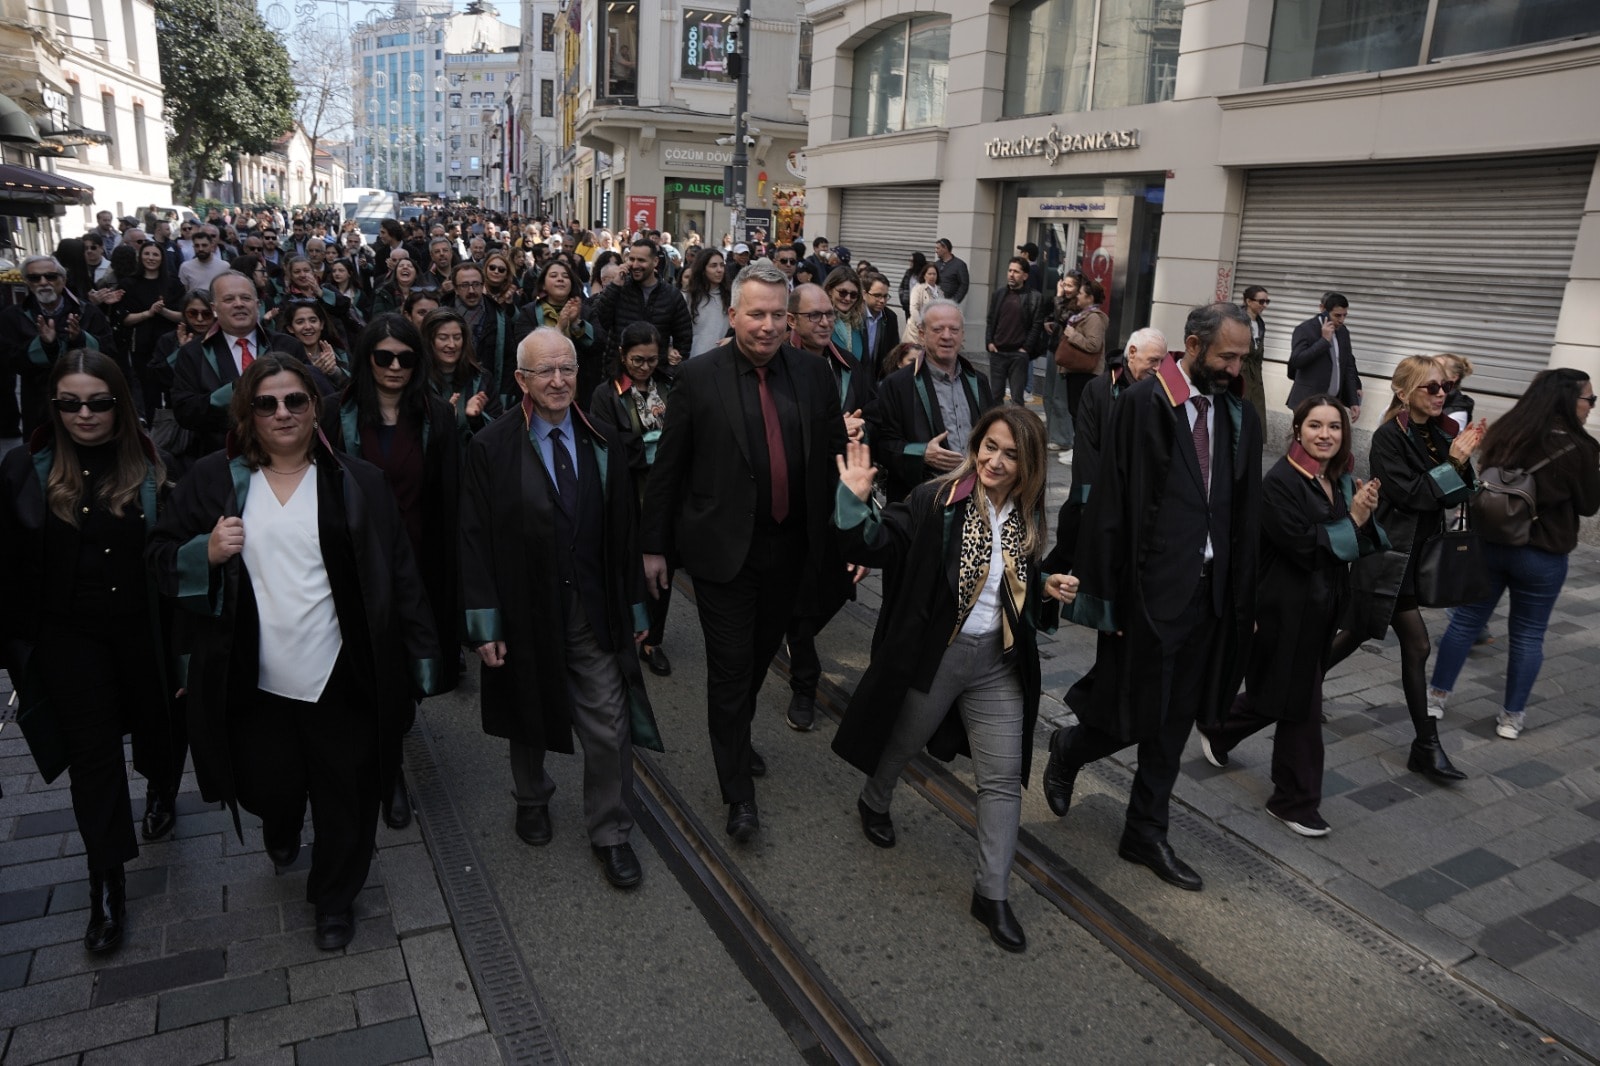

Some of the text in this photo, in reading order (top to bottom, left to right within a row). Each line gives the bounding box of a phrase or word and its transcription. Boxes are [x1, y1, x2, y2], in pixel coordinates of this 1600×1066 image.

[985, 135, 1044, 157] TÜRKİYE
[1061, 128, 1140, 153] BANKASI
[665, 148, 734, 162] ÇÖZÜM DÖVİ
[688, 184, 711, 195] ALIŞ
[713, 185, 725, 196] (B
